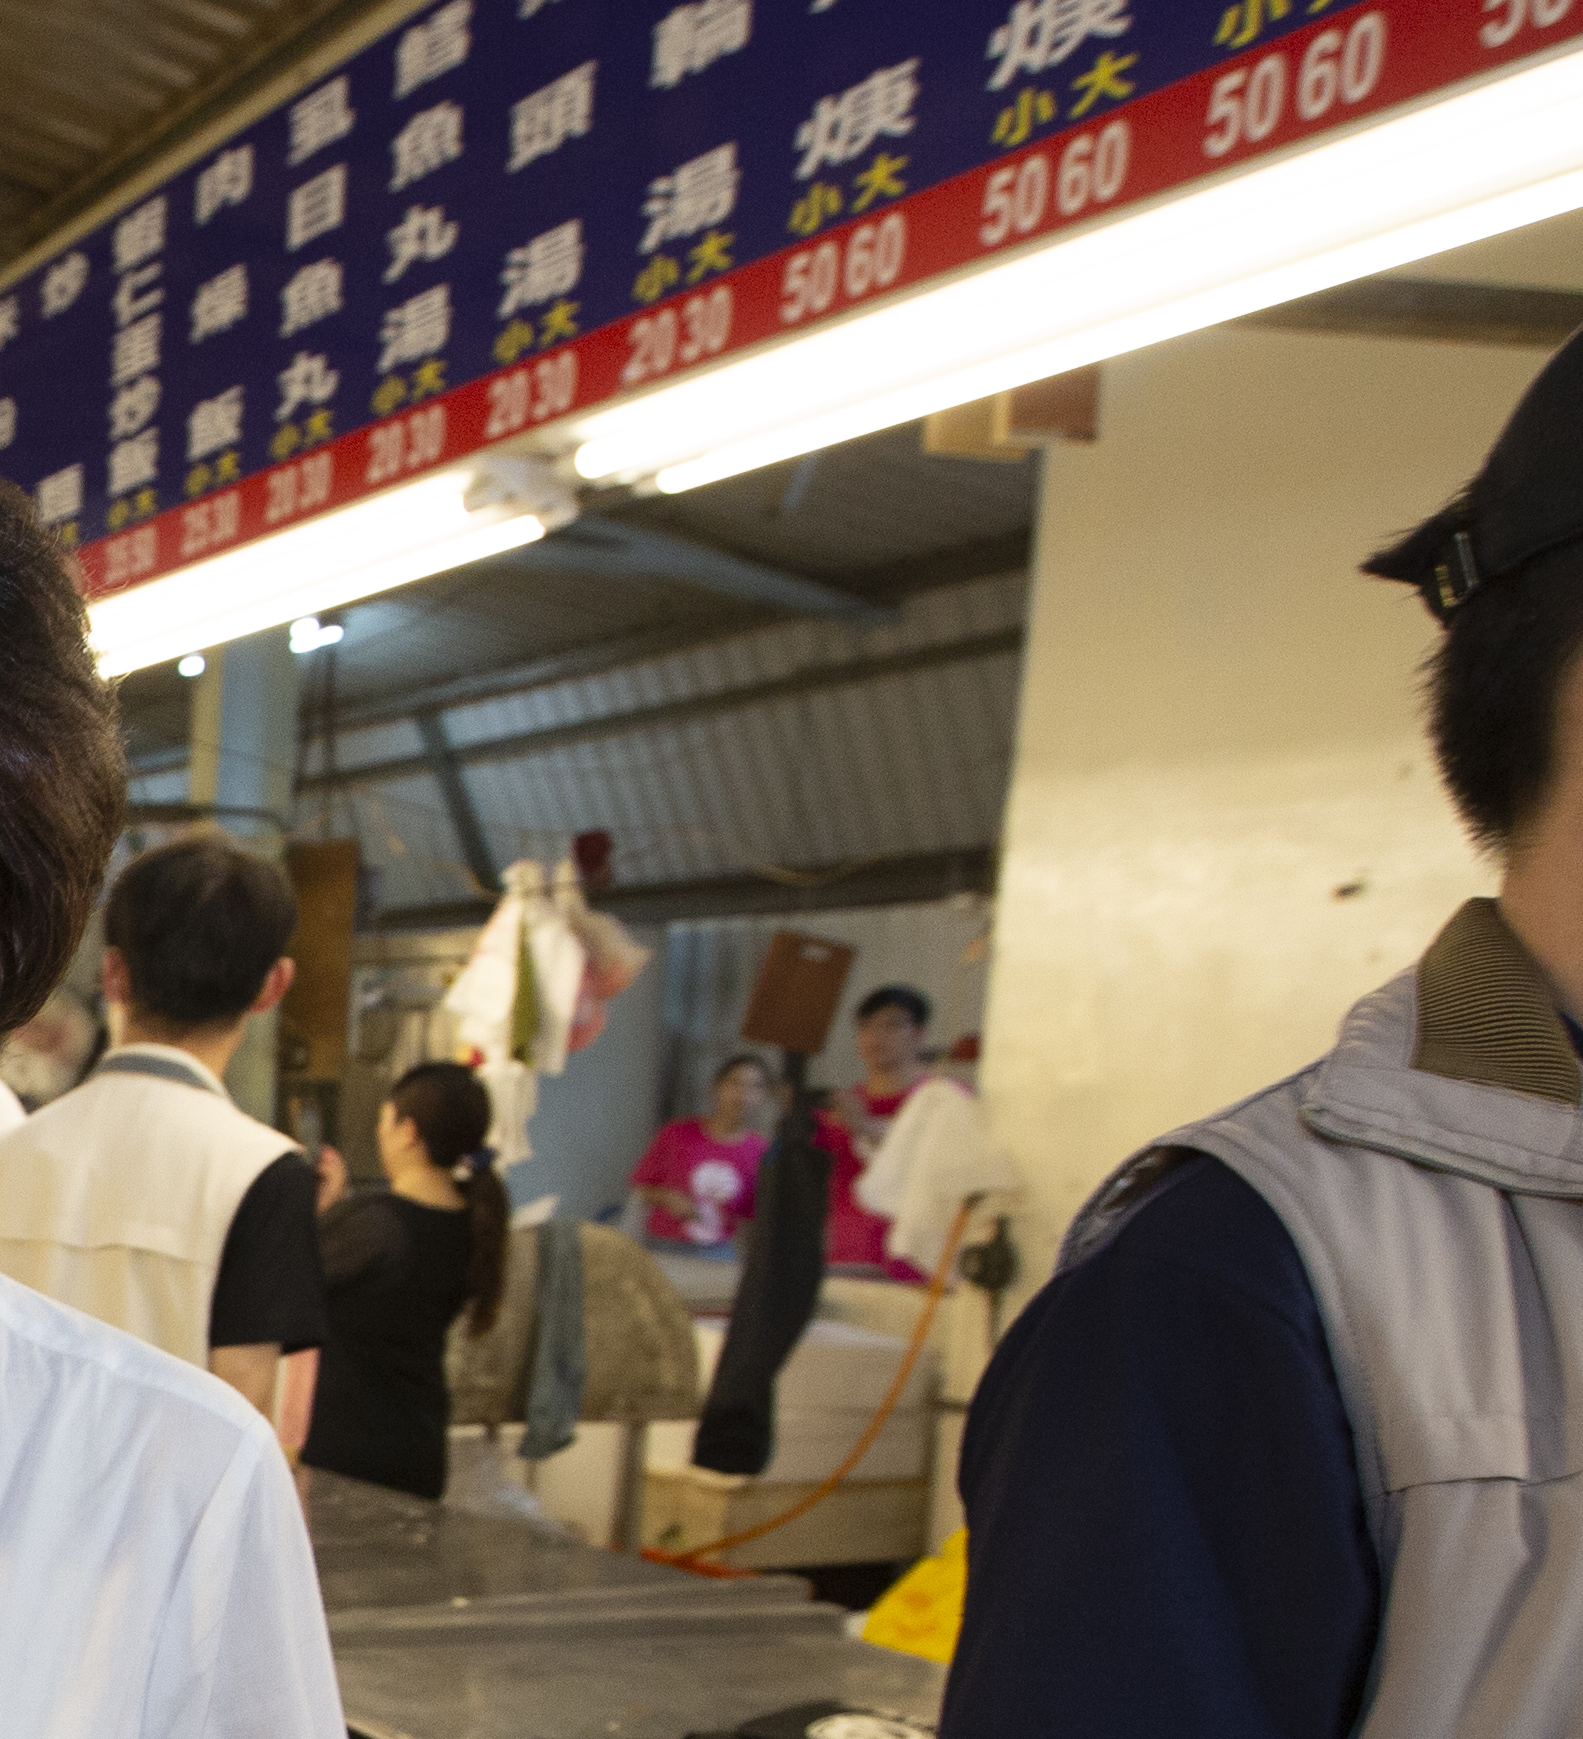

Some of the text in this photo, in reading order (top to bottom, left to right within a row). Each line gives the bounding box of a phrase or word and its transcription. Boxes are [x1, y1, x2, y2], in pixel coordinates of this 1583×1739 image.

[1203, 52, 1288, 157] 50
[1297, 11, 1388, 120] 60
[498, 0, 599, 320] 頭湯
[980, 119, 1131, 247] 50 60
[275, 74, 356, 421] 虱目魚丸
[780, 212, 907, 323] 50 60
